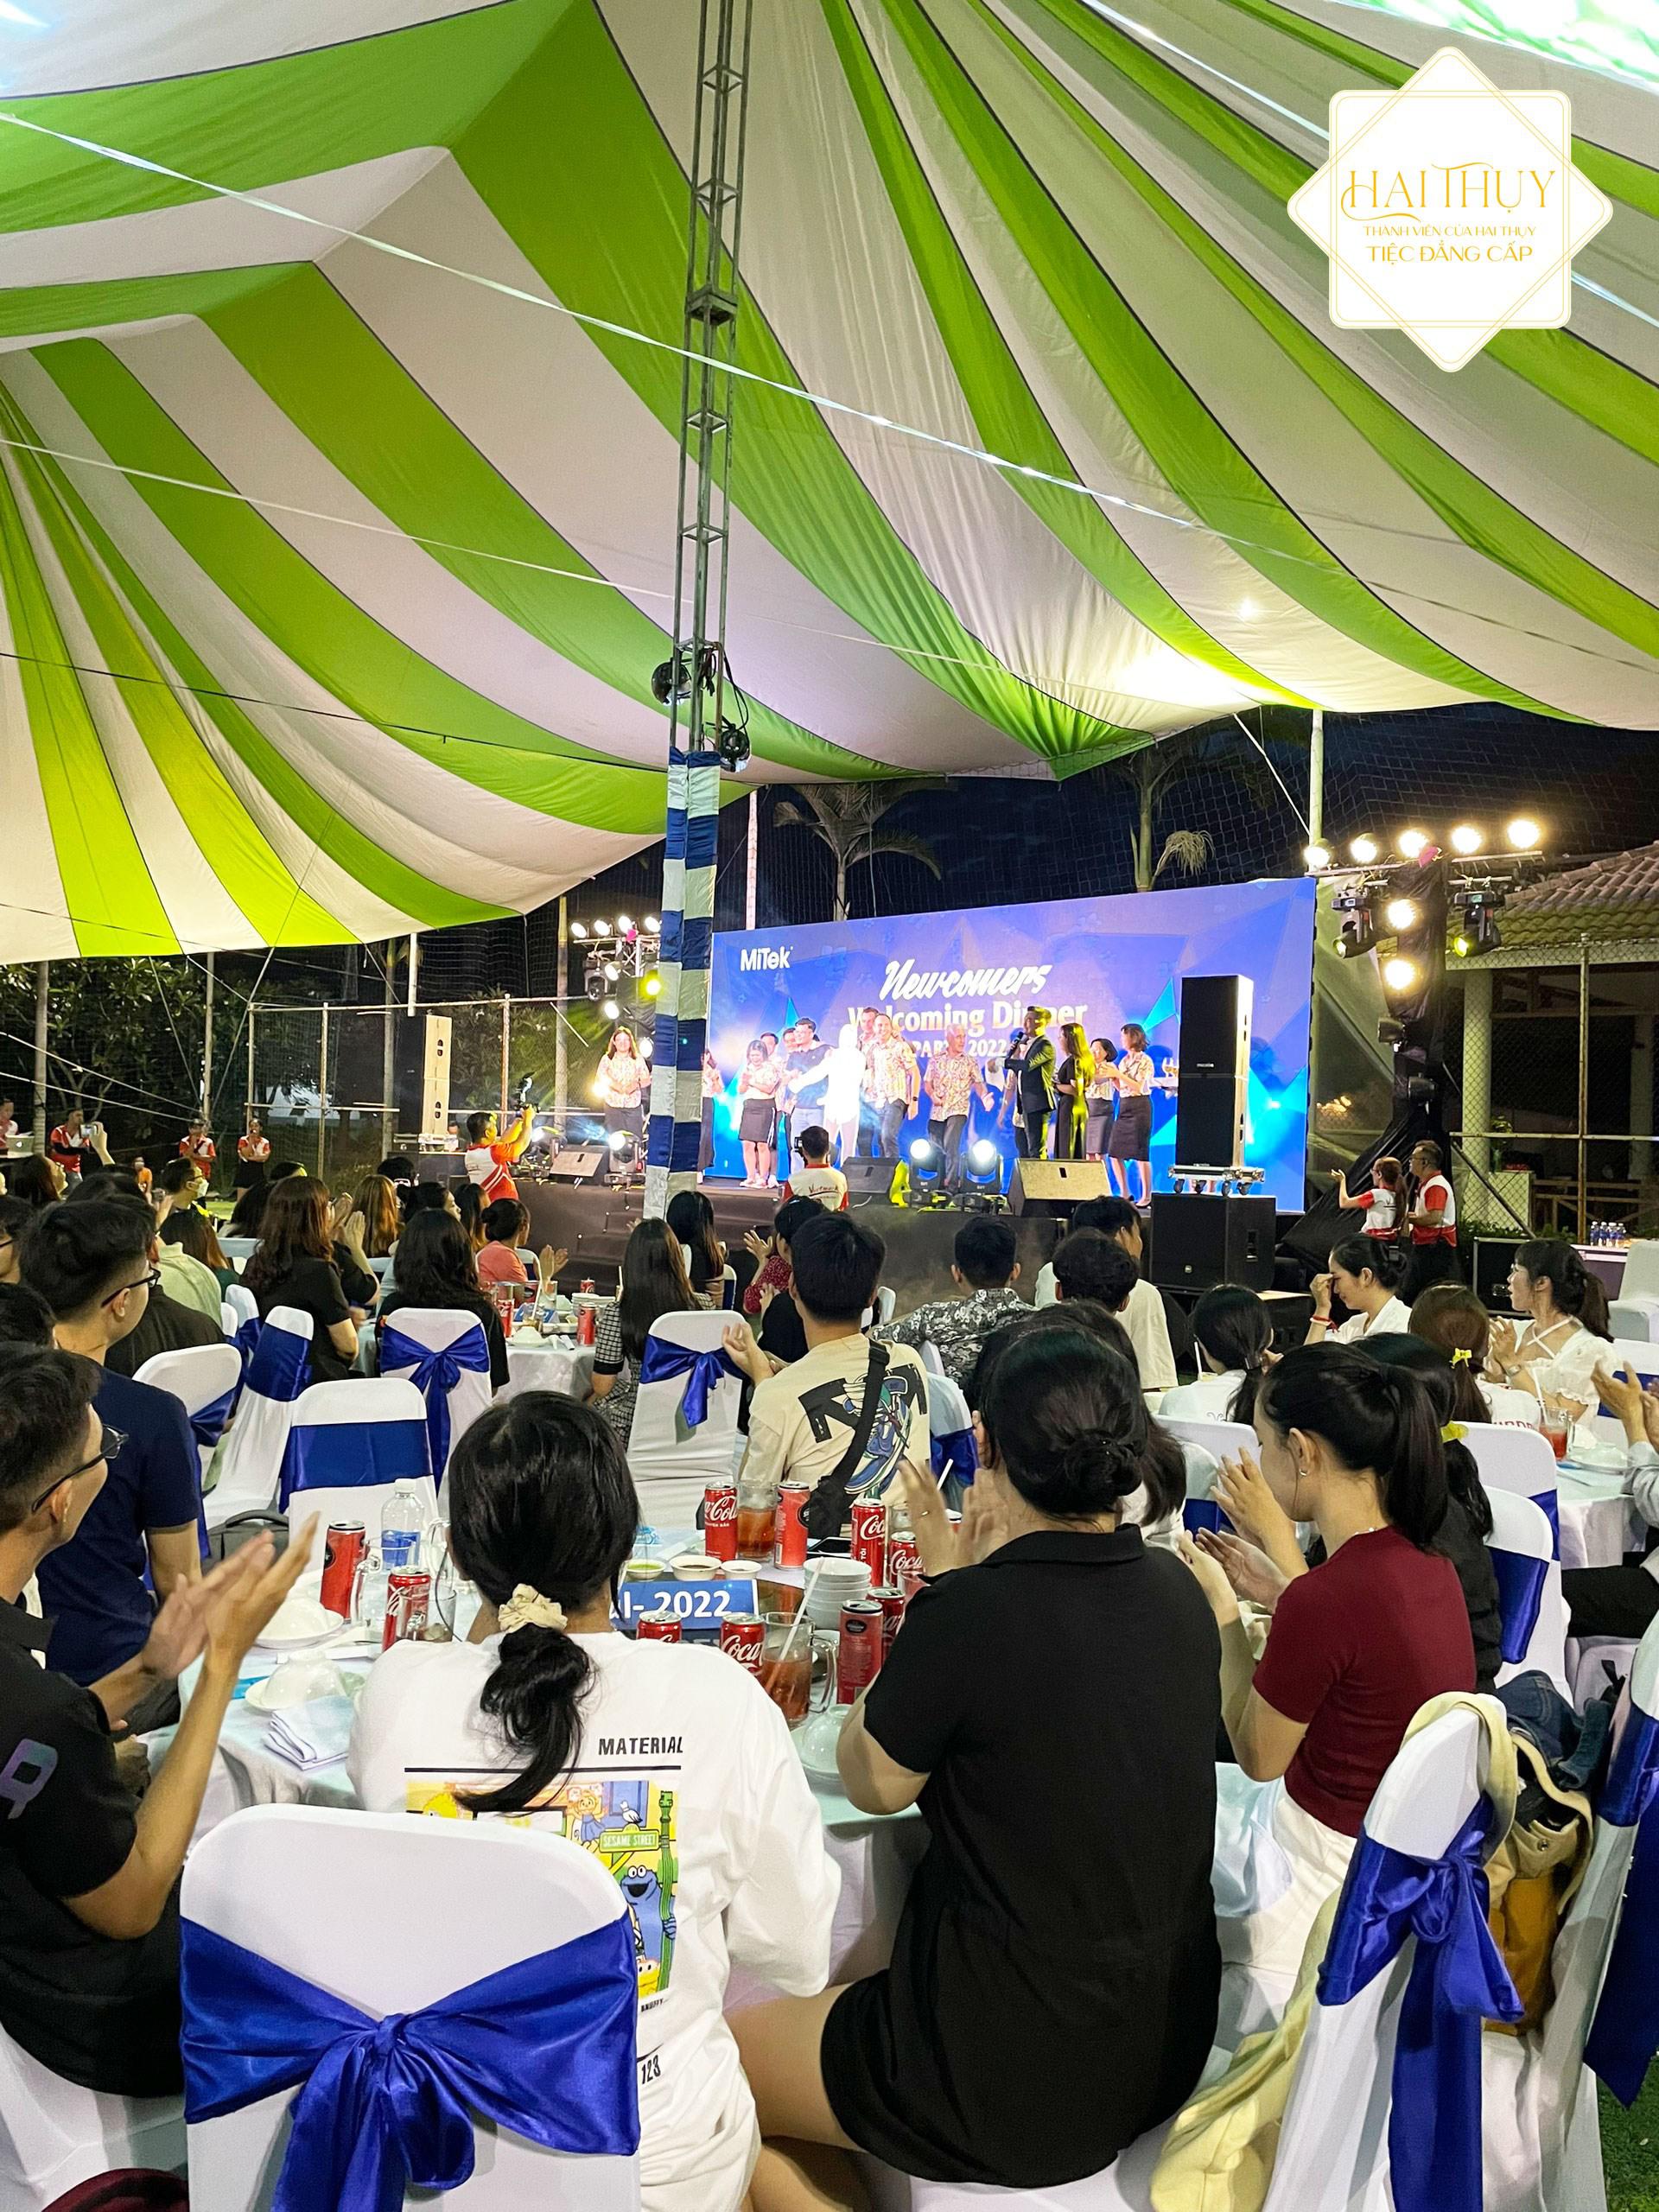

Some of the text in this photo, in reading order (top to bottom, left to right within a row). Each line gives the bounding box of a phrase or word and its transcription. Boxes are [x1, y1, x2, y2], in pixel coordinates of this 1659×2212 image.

[879, 958, 1052, 1001] Newcomers
[847, 1000, 1089, 1038] Wlcoming Diner
[968, 1039, 1007, 1057] 2022
[654, 1590, 732, 1618] 2022
[598, 1736, 683, 1756] MATERIAL
[603, 1833, 657, 1847] SESAME STREET
[641, 2054, 661, 2084] 123
